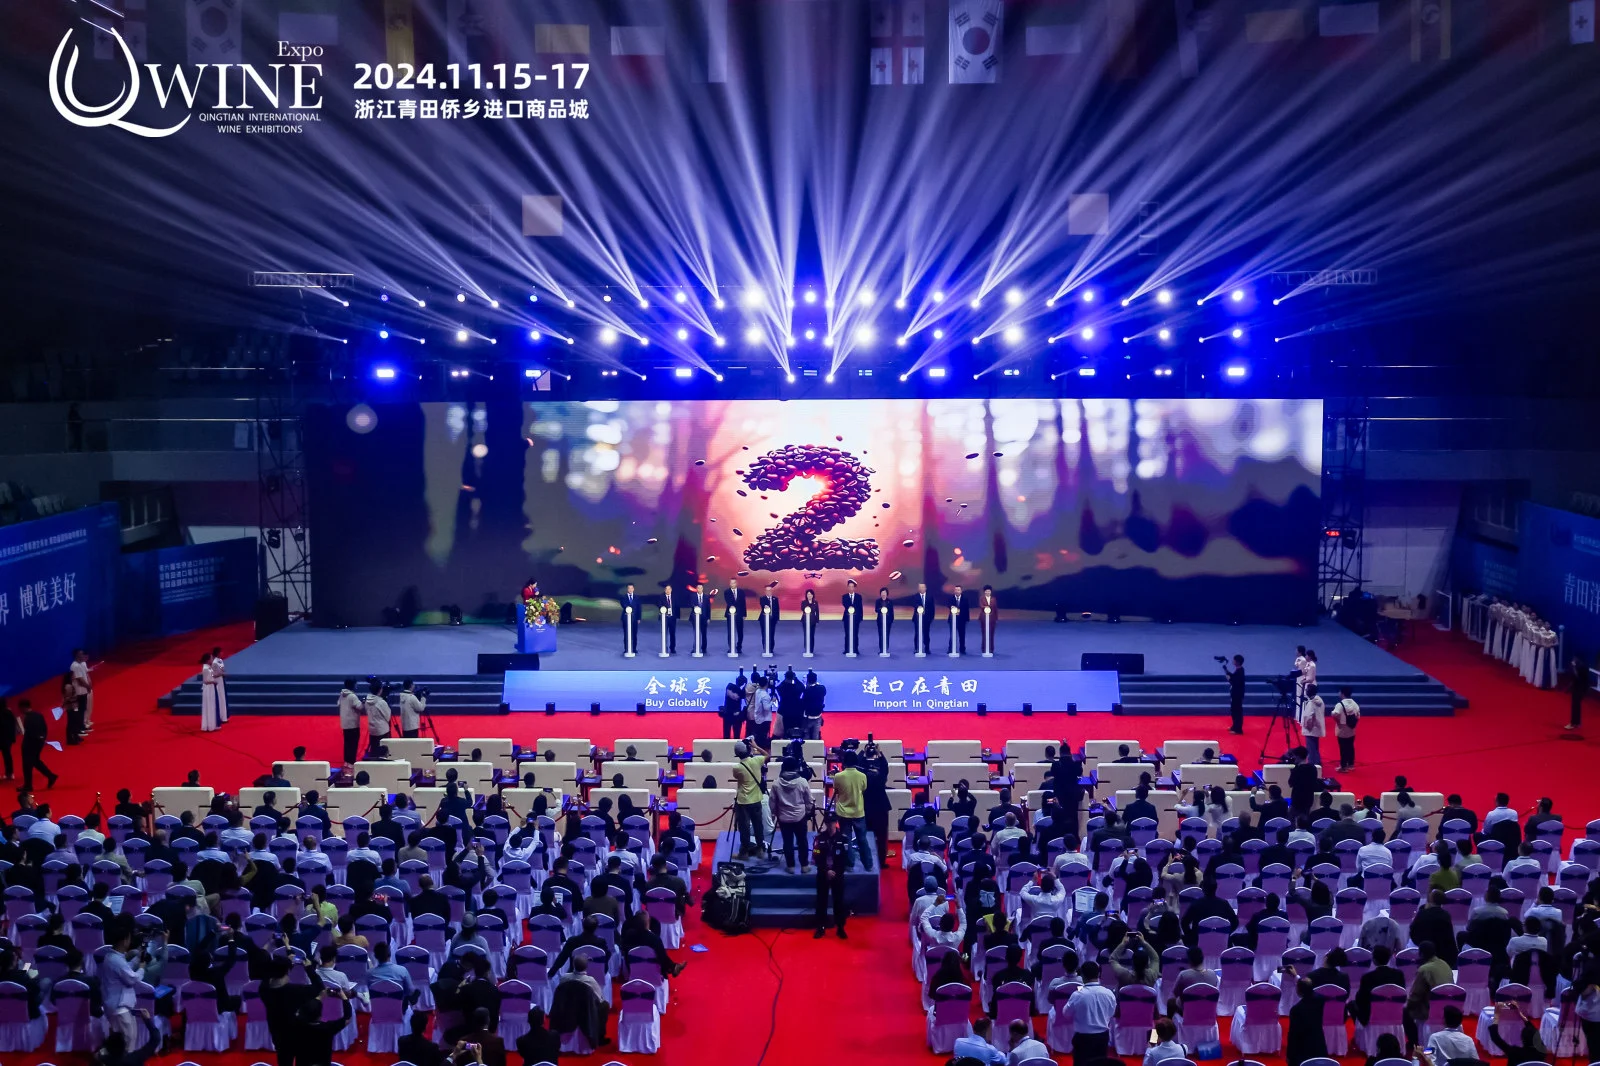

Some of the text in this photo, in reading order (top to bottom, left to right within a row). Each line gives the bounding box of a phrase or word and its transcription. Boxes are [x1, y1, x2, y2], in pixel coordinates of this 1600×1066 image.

[741, 443, 881, 572] 2
[19, 571, 77, 620] 博览美好
[644, 675, 712, 696] 全球买
[861, 675, 979, 696] 进口在青田
[645, 697, 709, 709] Buy Globally
[873, 699, 969, 710] Import In Qingtian
